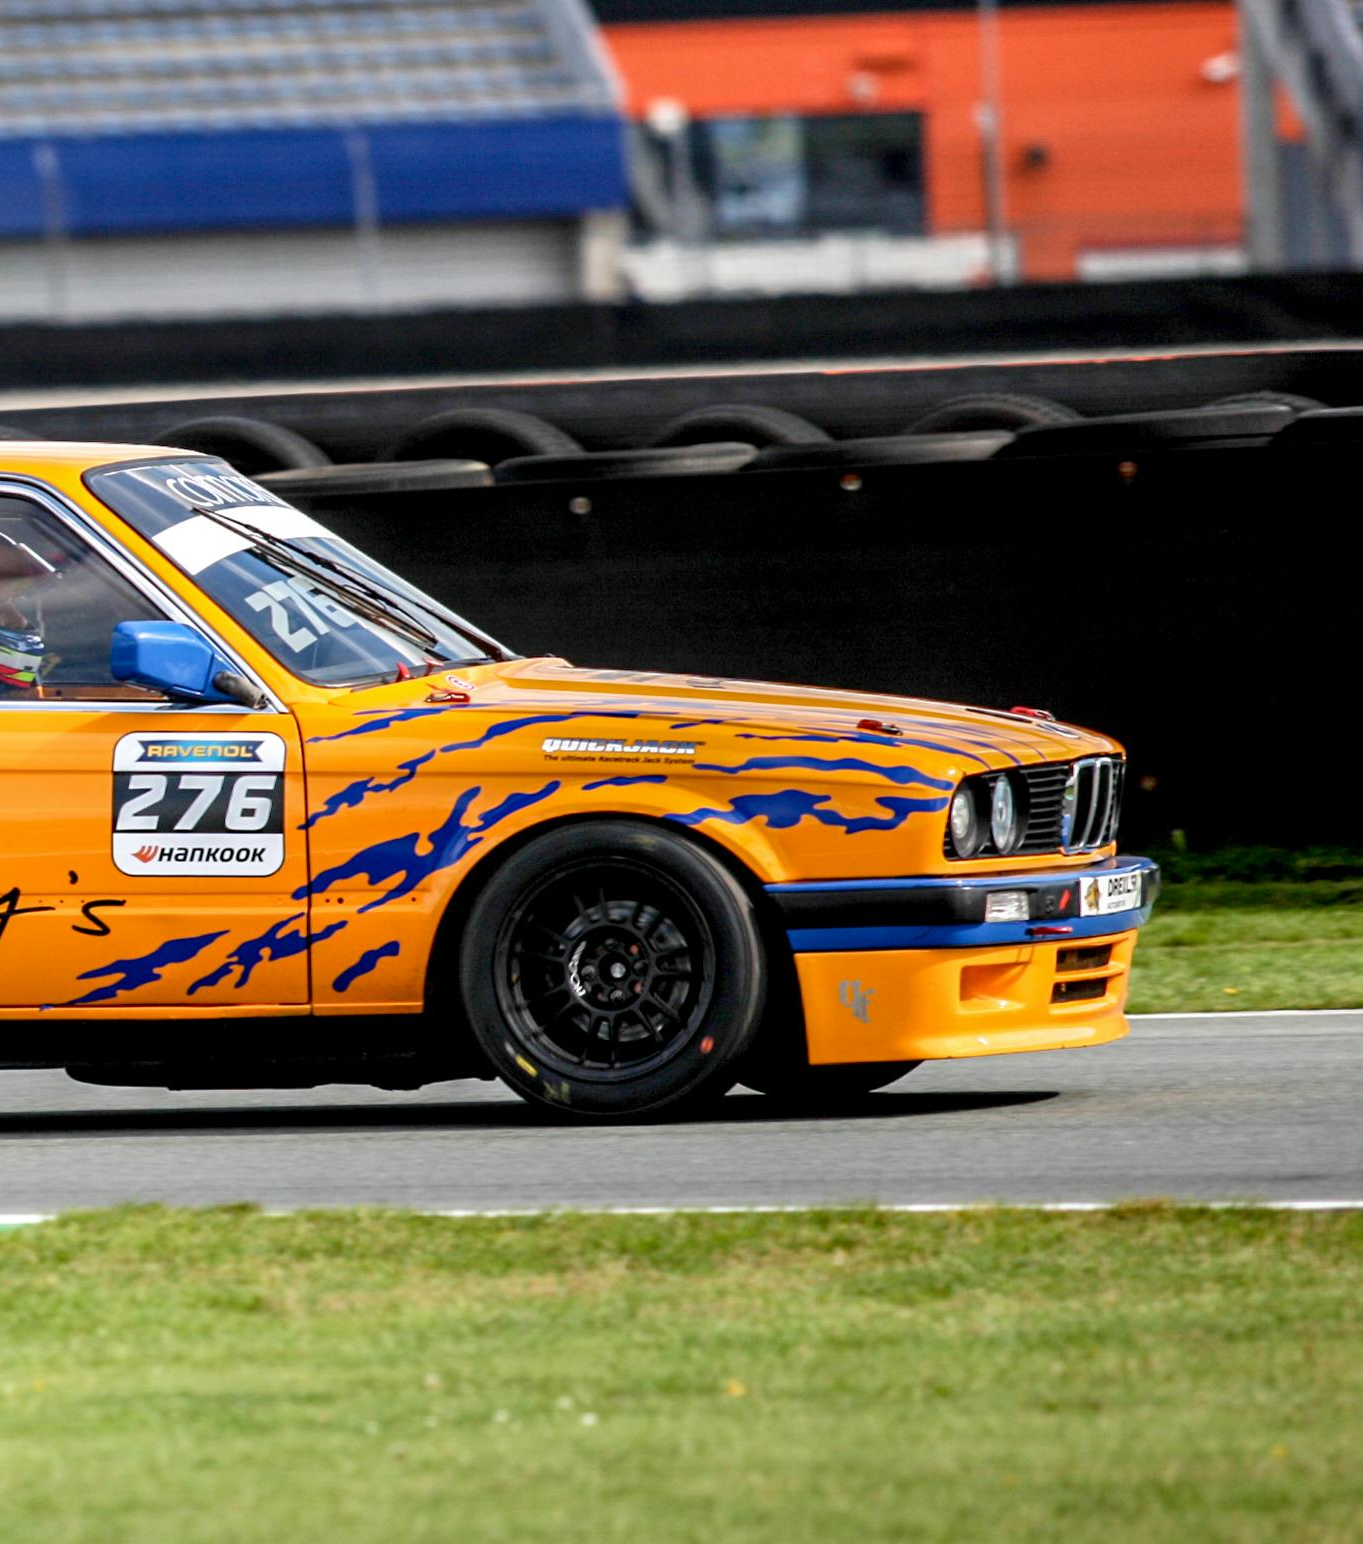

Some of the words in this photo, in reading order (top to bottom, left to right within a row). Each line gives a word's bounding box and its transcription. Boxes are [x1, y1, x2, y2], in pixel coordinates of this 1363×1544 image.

[147, 745, 253, 758] RAVENOL
[542, 737, 699, 755] QUICKJACK
[116, 774, 277, 831] 276
